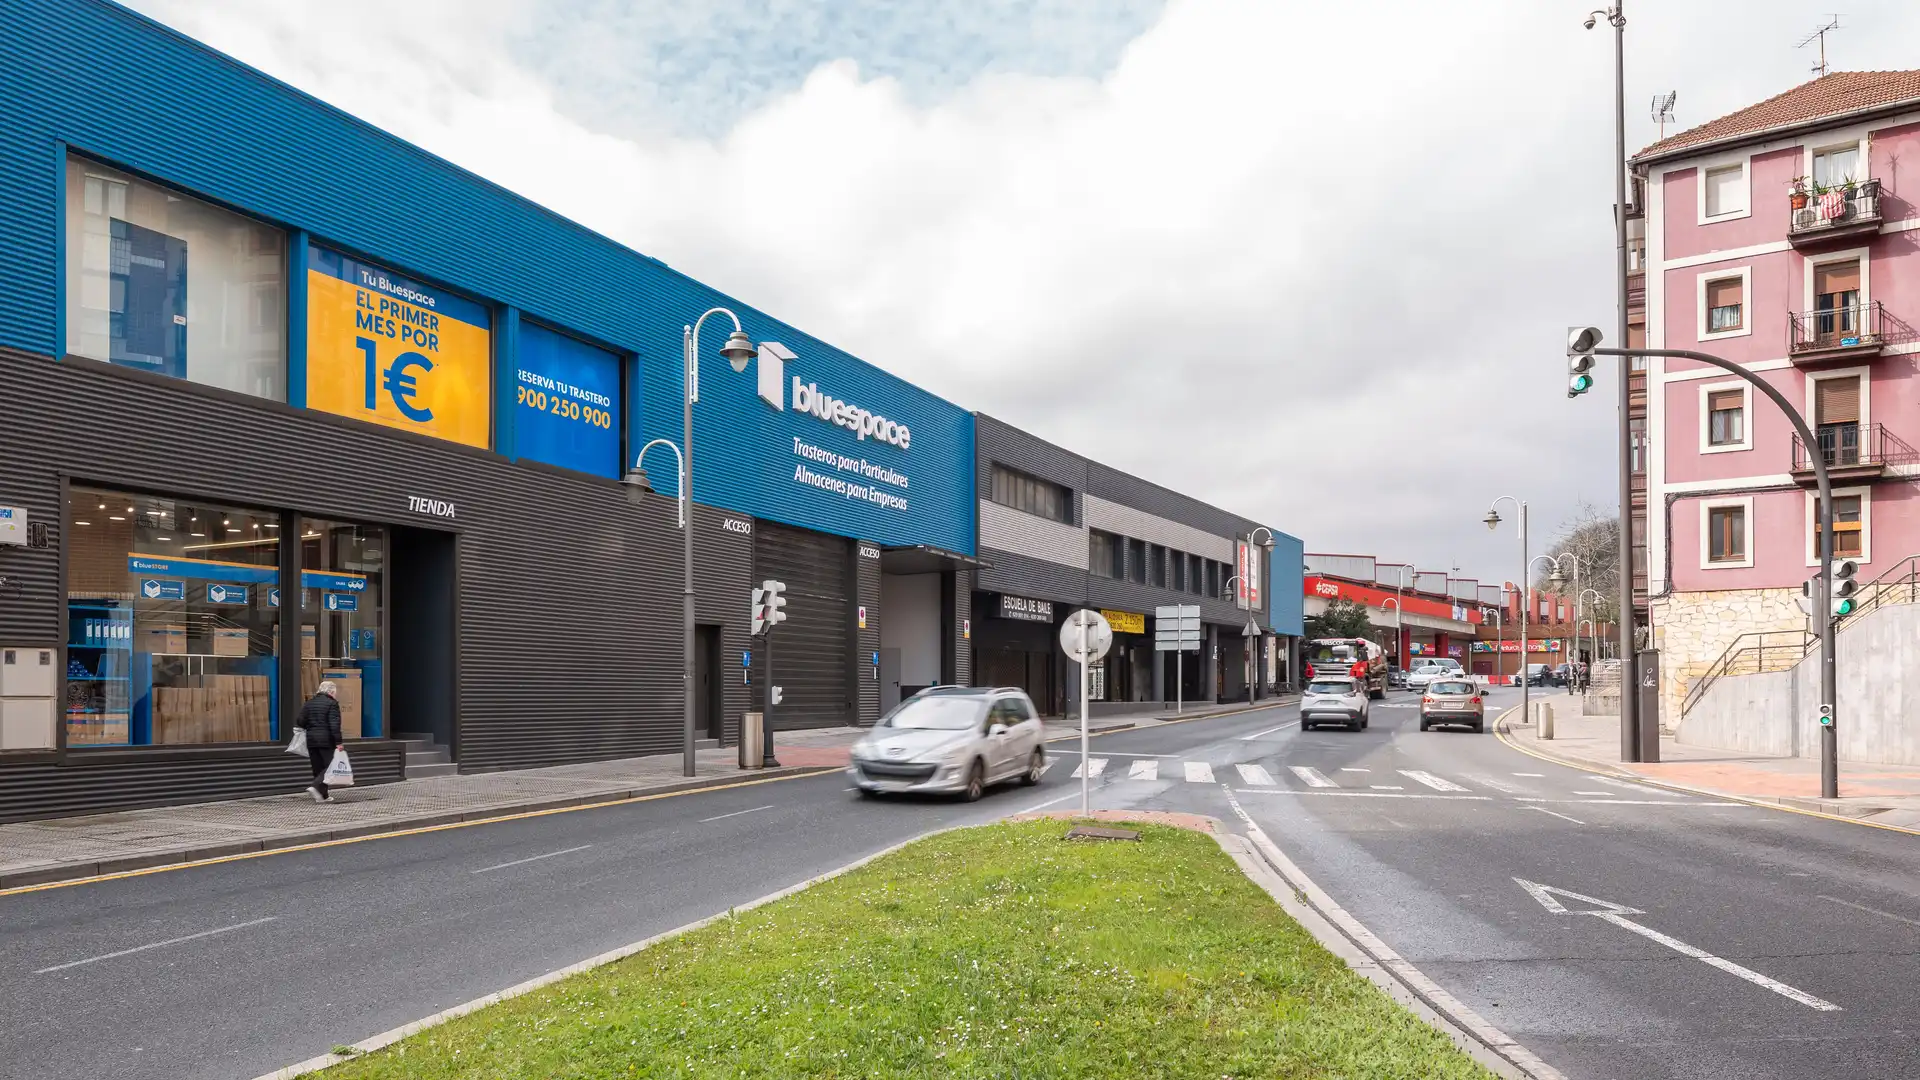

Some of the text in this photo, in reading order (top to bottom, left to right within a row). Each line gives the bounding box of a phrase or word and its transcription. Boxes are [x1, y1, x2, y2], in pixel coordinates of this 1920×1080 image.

[361, 270, 435, 307] Tu Bluespace
[356, 290, 439, 332] EL PRIMER
[356, 309, 439, 352] MES POR
[356, 336, 434, 422] 1€
[556, 381, 568, 394] TU
[569, 386, 610, 407] TRASTERO
[518, 385, 611, 429] 900 250 900
[792, 376, 911, 449] bluespace
[793, 437, 908, 488] Trasteros para Particulares
[408, 495, 455, 518] TIENDA
[794, 465, 907, 510] Almacenes para Empresas
[723, 518, 751, 535] ACCESO
[859, 546, 880, 559] ACCESO
[1003, 595, 1051, 614] ESCUELA DE BAILE
